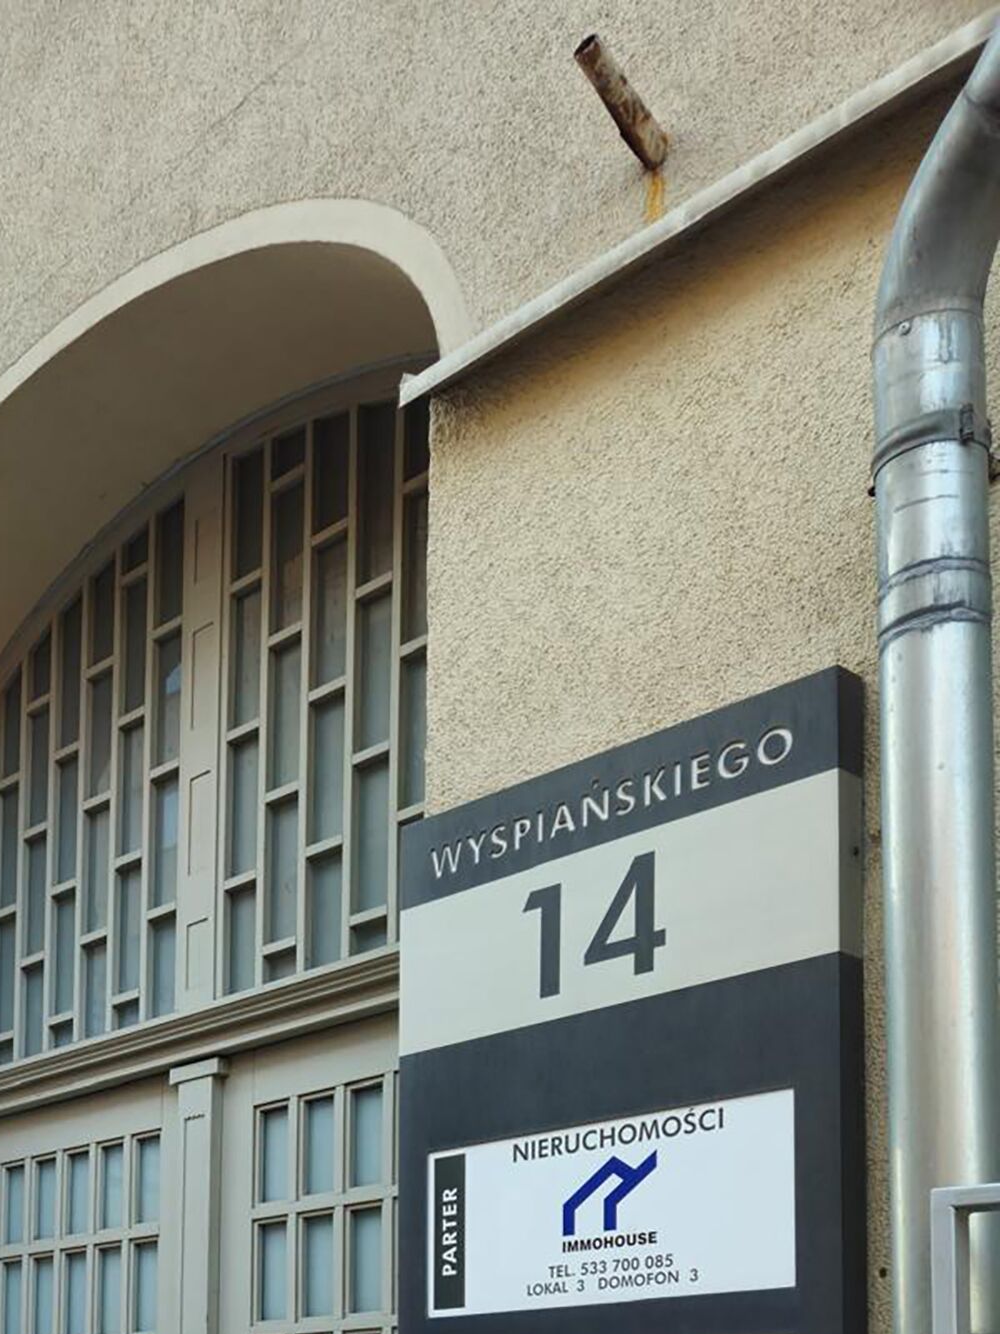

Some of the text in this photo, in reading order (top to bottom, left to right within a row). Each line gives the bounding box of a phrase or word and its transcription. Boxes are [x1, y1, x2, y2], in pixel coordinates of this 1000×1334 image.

[430, 727, 794, 879] WYSPIAŃSKIEGO
[522, 850, 666, 1000] 14
[512, 1107, 724, 1163] NIERUCHOMOŚCI
[442, 1187, 458, 1277] PARTER
[562, 1231, 658, 1253] IMMOHOUSE
[526, 1269, 698, 1297] LOKAL 3 DOMOFON 3
[549, 1254, 674, 1279] TEL. 533 700 085
